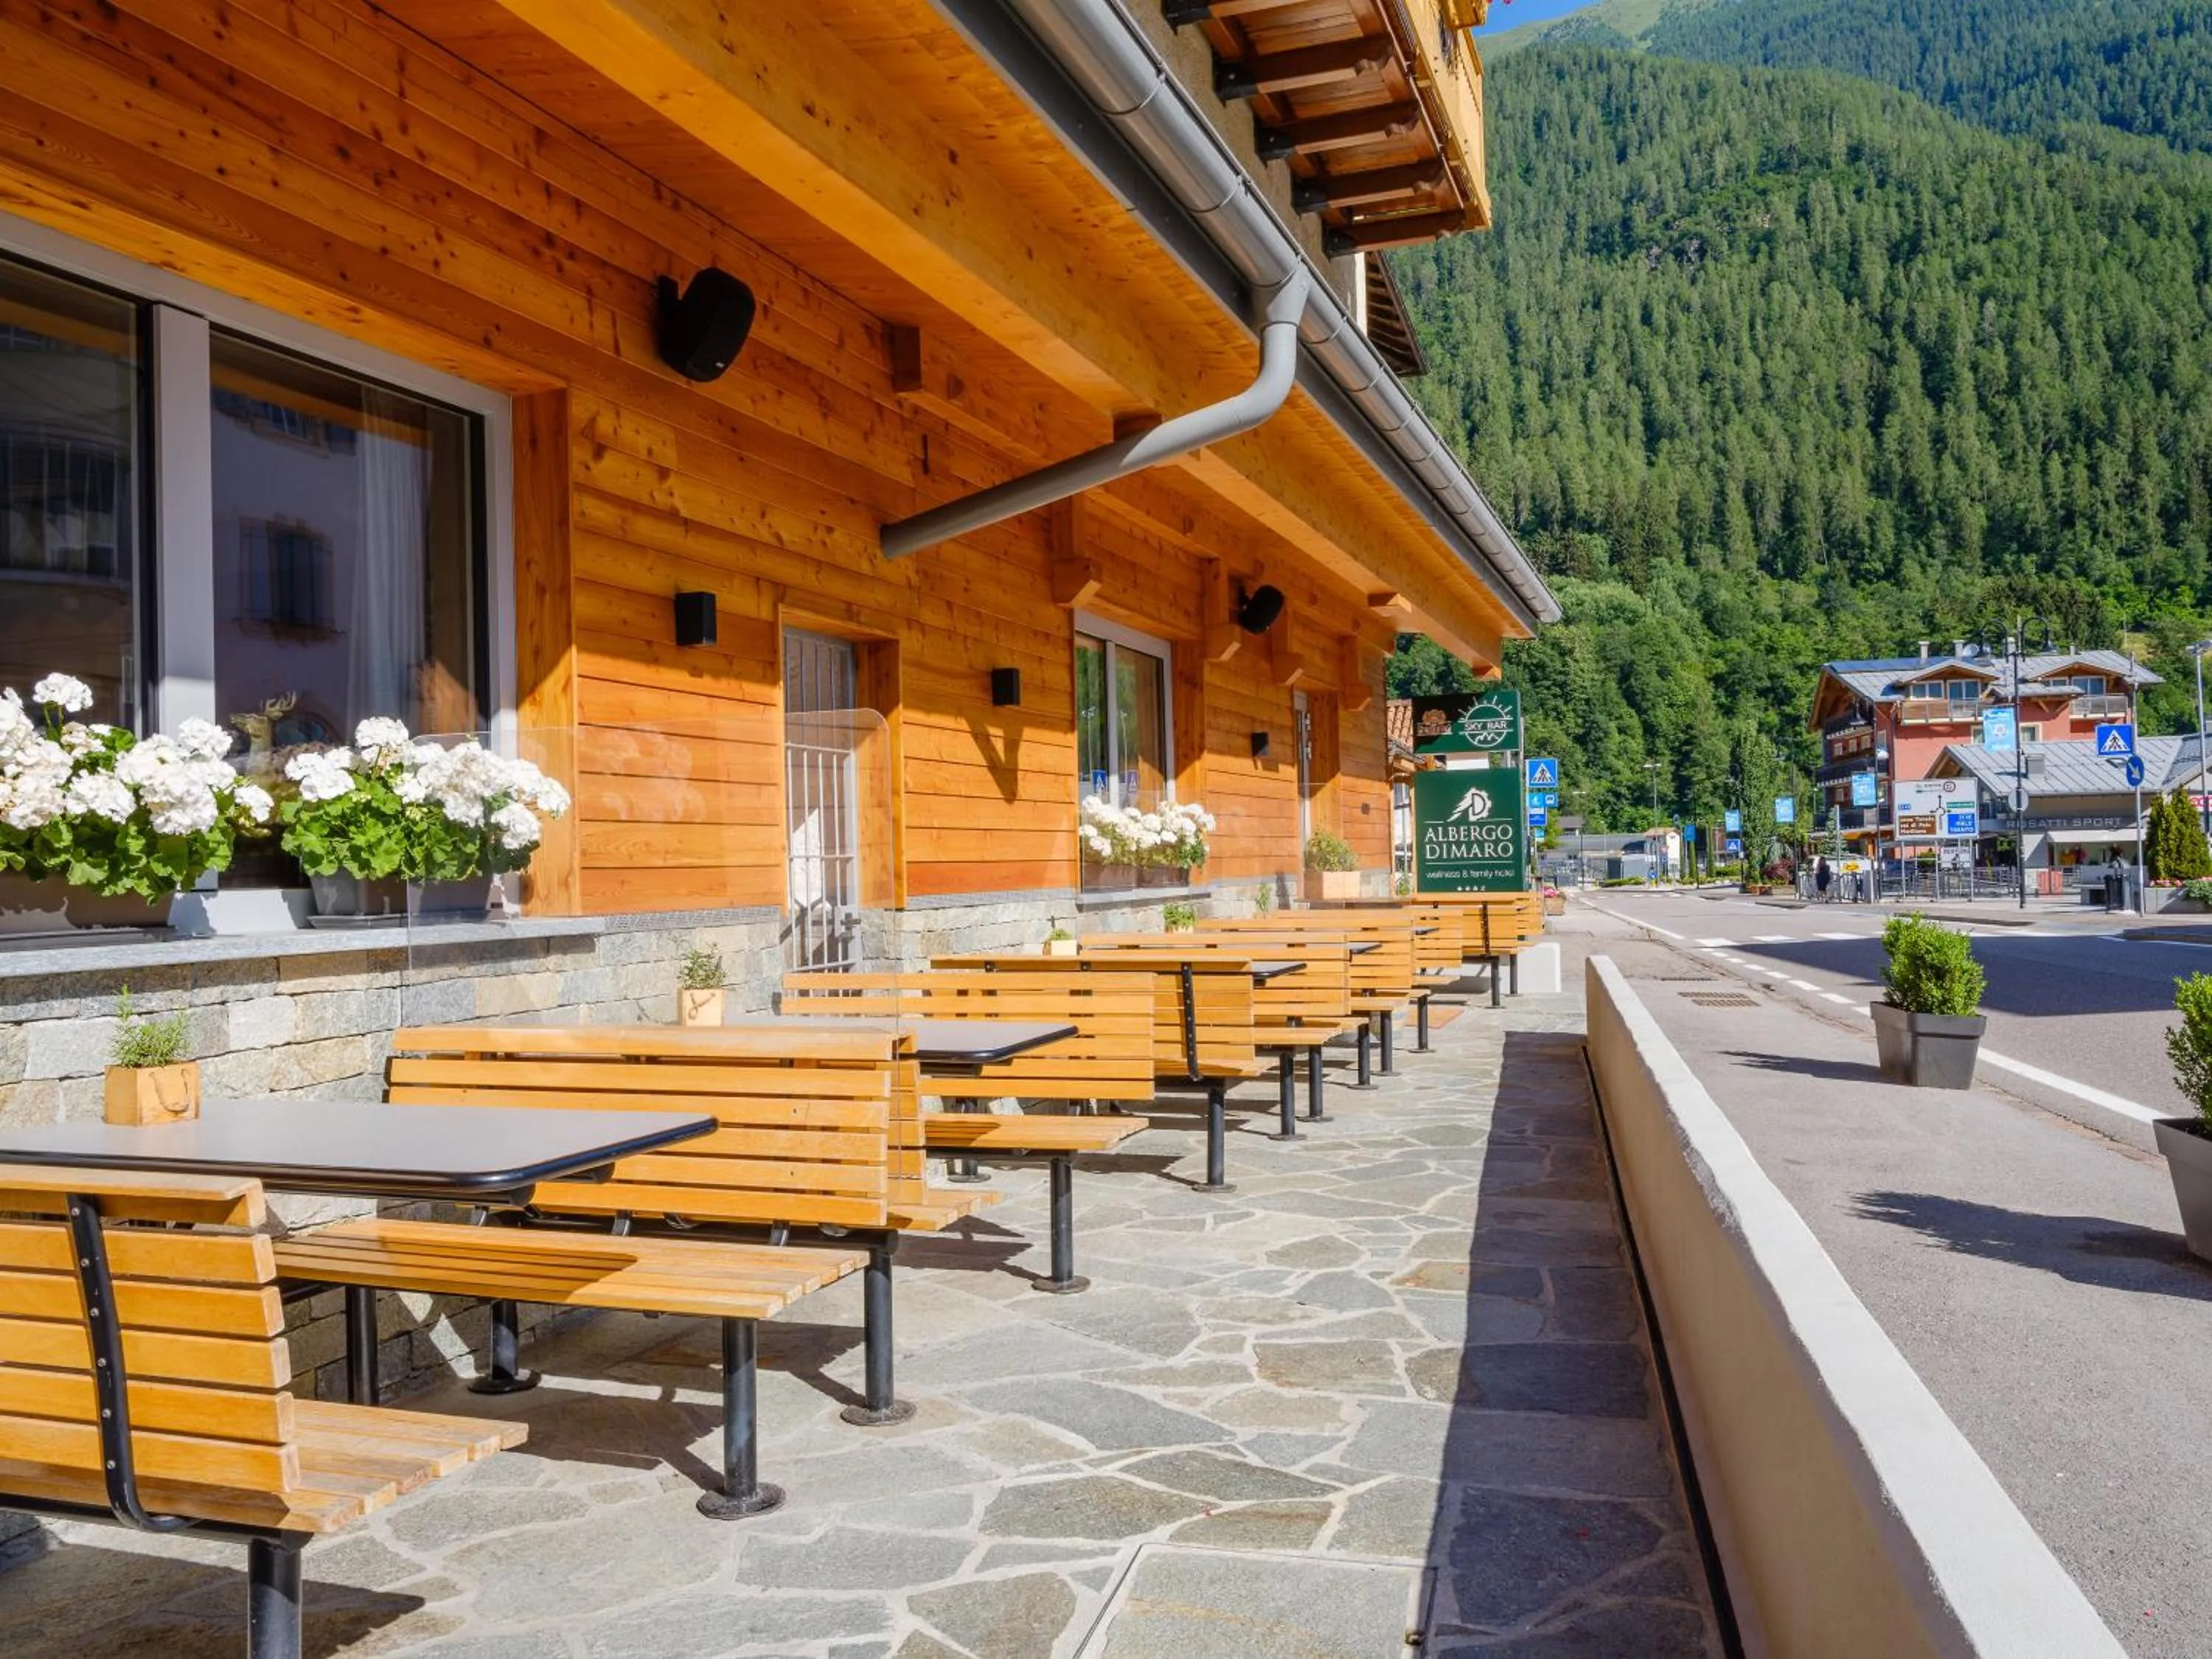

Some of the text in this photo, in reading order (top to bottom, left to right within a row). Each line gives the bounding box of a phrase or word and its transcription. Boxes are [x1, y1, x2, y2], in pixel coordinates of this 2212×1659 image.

[1464, 720, 1507, 731] SKY BAR
[2073, 817, 2121, 827] SPORT
[1425, 824, 1513, 841] ALBERGO
[1425, 841, 1514, 859] DIMARO
[1425, 869, 1514, 879] wellness & family hotel
